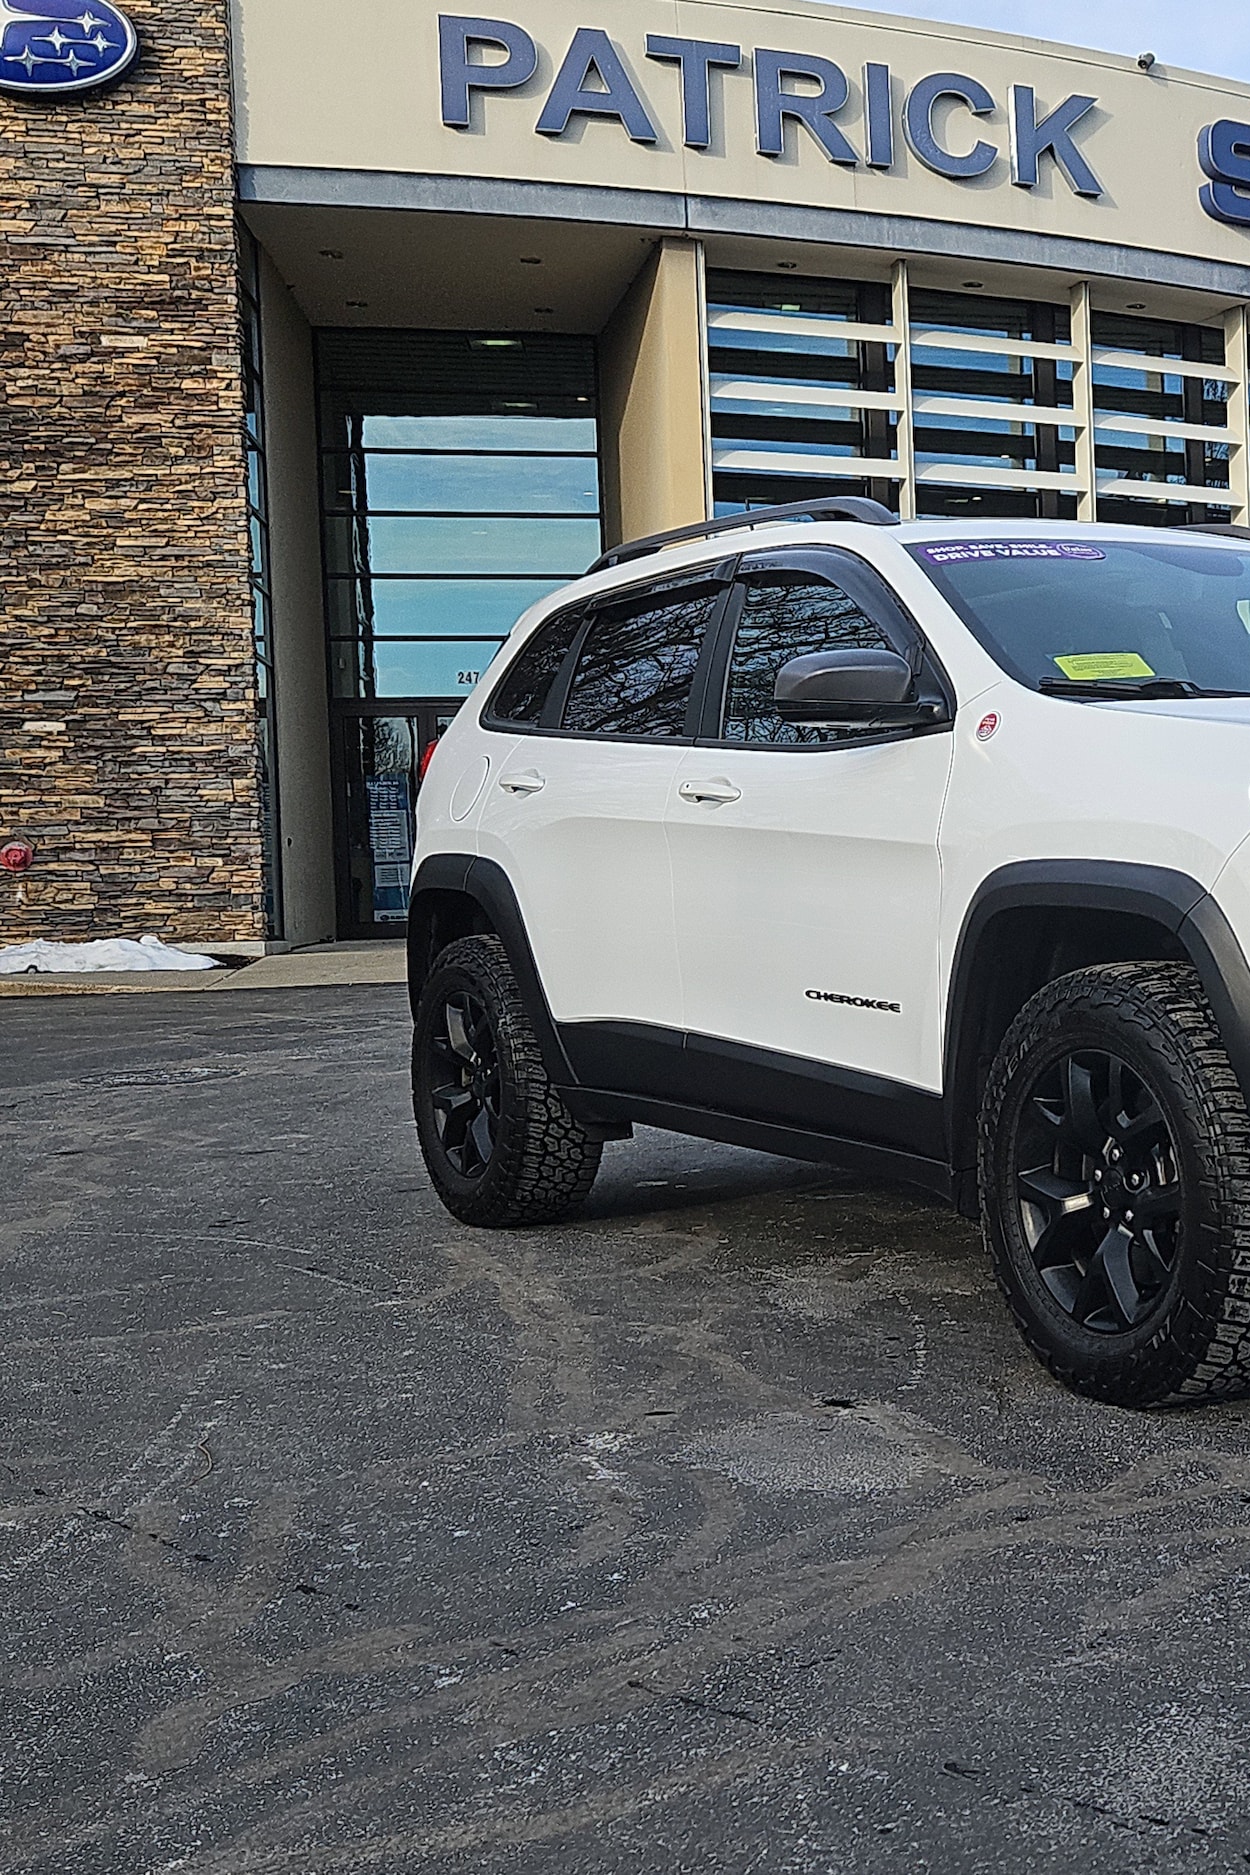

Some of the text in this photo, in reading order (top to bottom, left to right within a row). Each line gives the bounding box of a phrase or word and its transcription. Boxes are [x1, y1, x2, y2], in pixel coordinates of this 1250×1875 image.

[437, 13, 1104, 199] PATRICK
[933, 549, 996, 562] DRIVE
[457, 671, 480, 685] 247
[804, 989, 902, 1014] CHEROKEE
